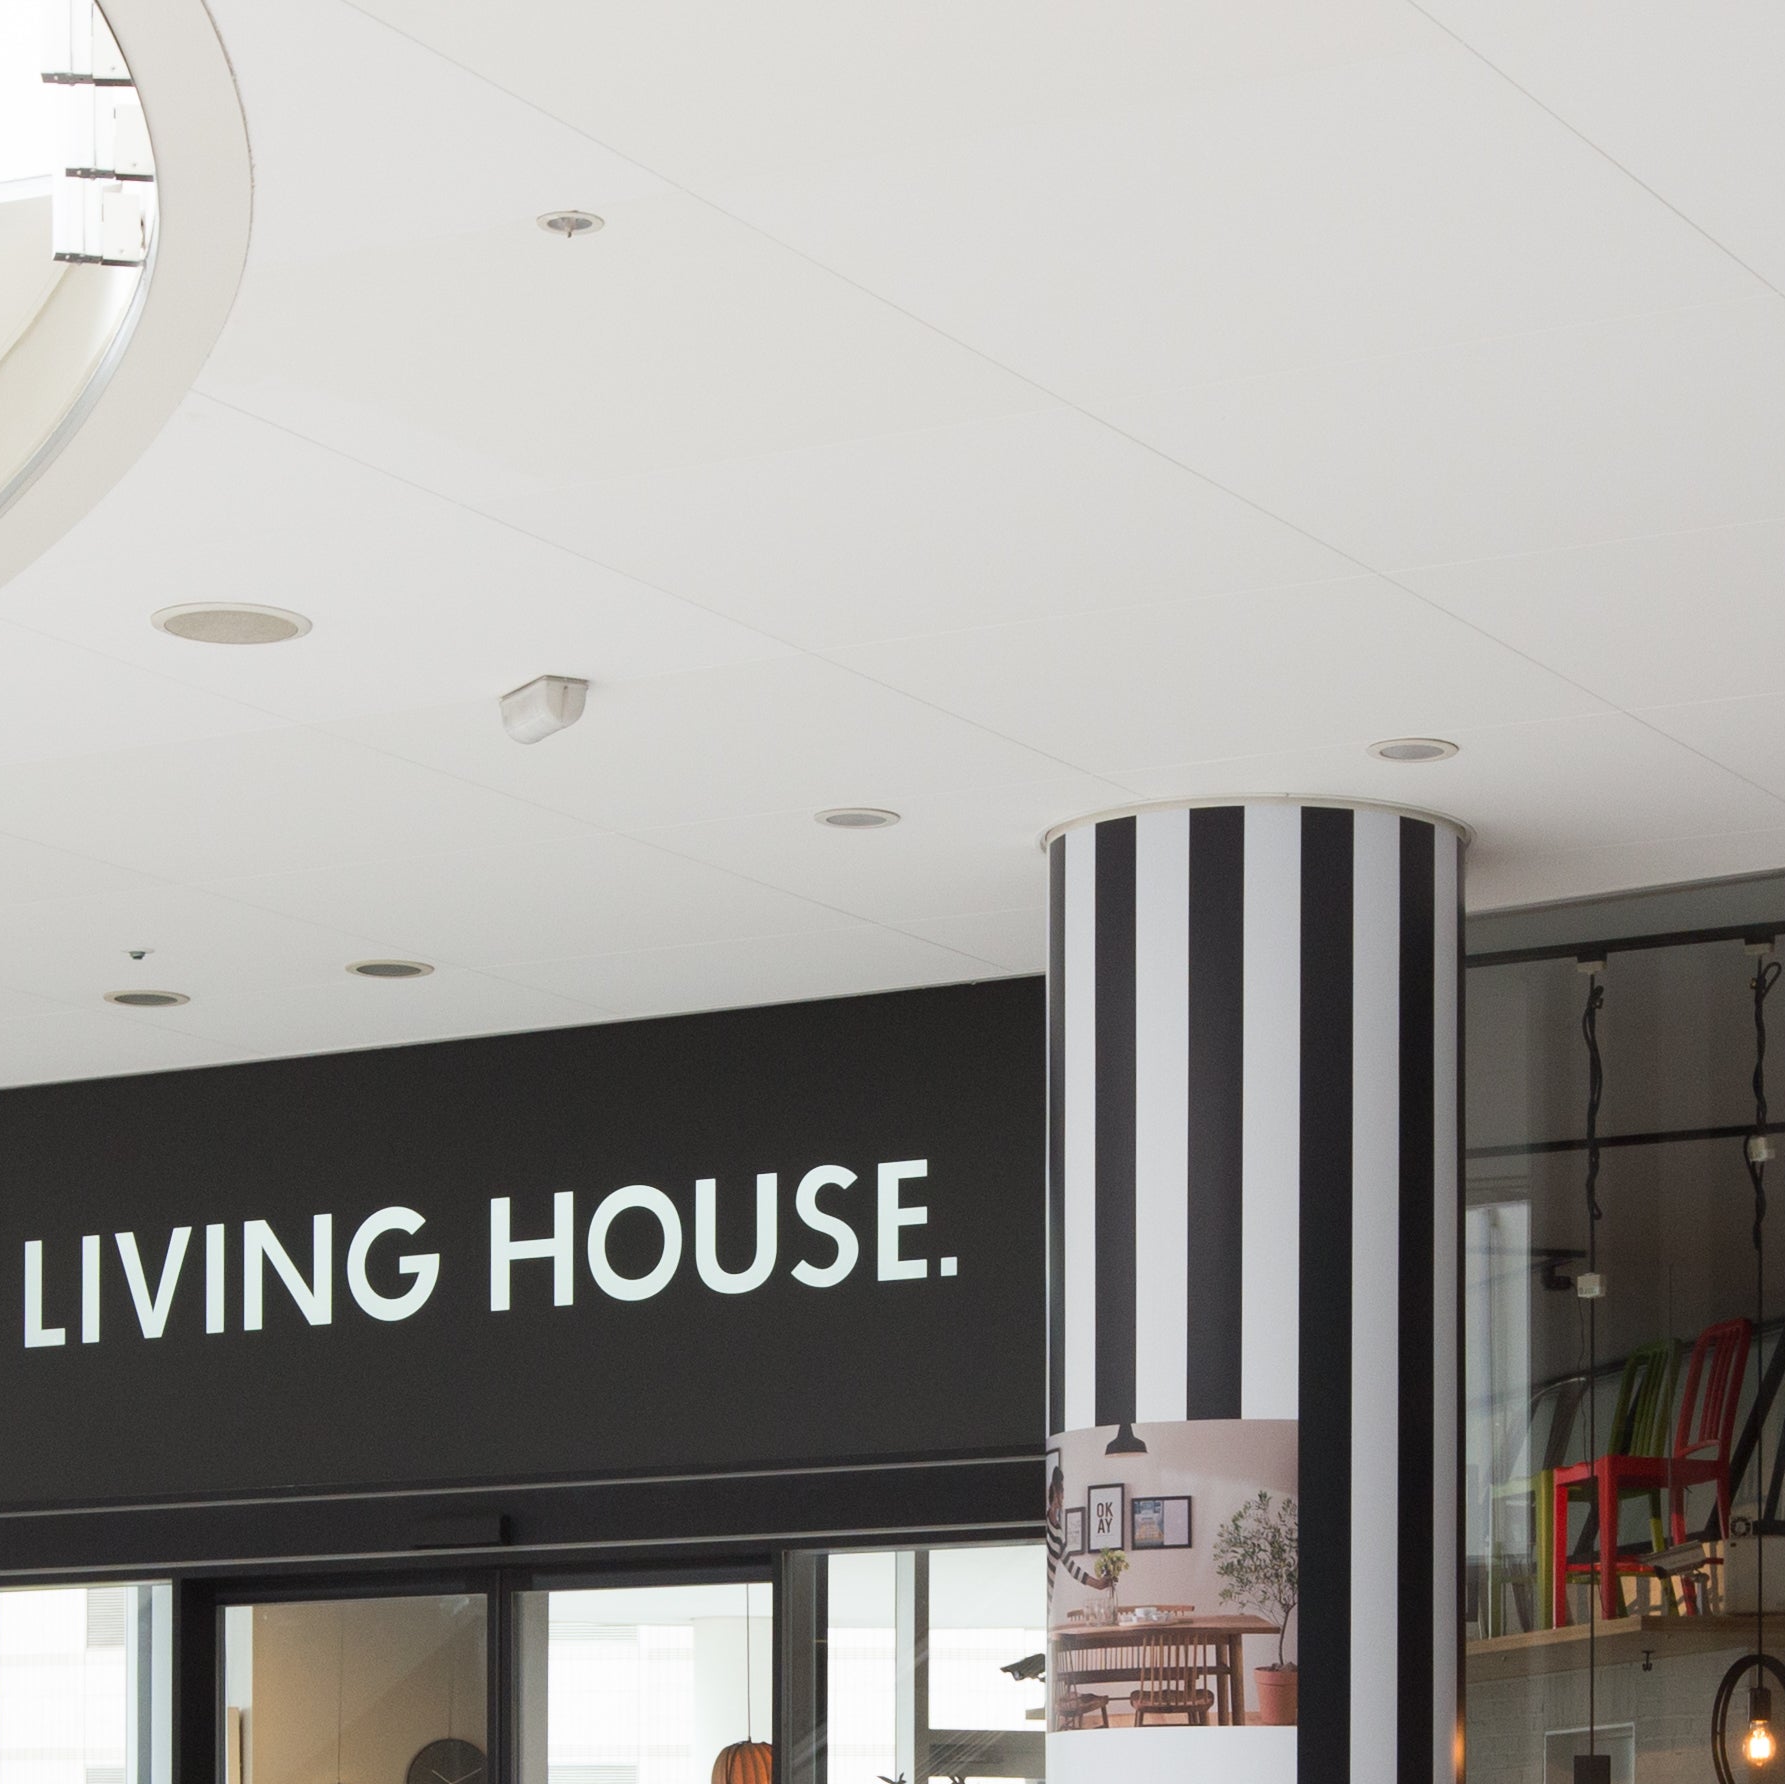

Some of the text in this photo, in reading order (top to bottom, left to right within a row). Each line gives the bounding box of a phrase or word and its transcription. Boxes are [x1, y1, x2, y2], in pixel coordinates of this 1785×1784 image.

[24, 1159, 958, 1348] LIVING HOUSE.
[1097, 1502, 1114, 1518] OK
[1097, 1518, 1113, 1534] AY
